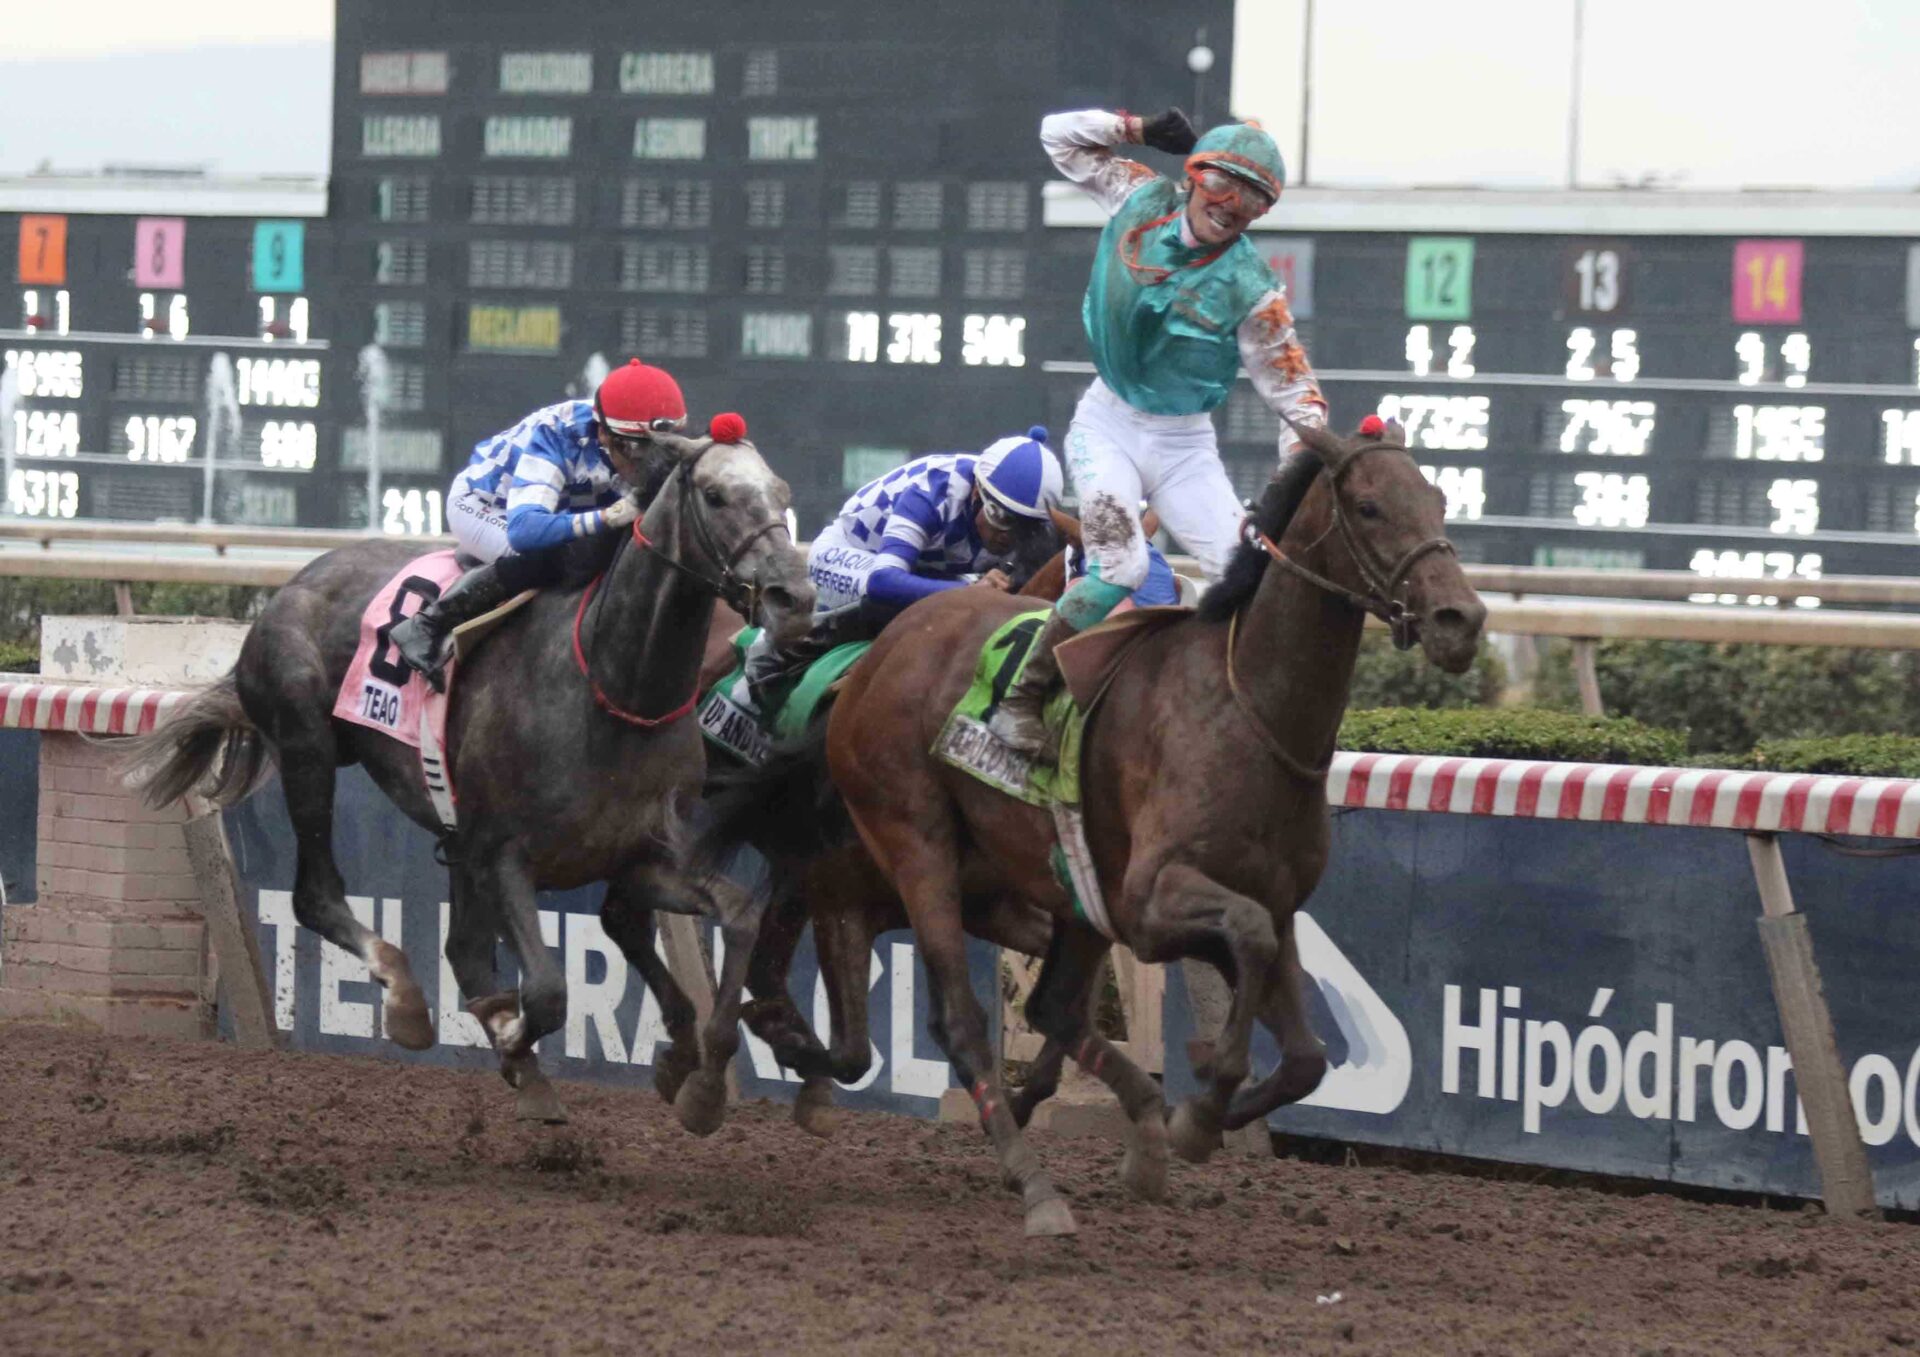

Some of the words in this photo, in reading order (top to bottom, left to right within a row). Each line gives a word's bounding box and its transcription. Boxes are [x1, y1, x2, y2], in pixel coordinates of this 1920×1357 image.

[35, 226, 49, 273] 7
[151, 227, 165, 277] 8
[269, 230, 286, 279] 9
[1420, 249, 1459, 306] 12
[1574, 249, 1620, 312] 13
[1746, 254, 1788, 311] 14
[383, 489, 441, 536] 241
[809, 564, 860, 602] HERRERA
[363, 685, 399, 727] TEAO
[703, 695, 727, 728] UP
